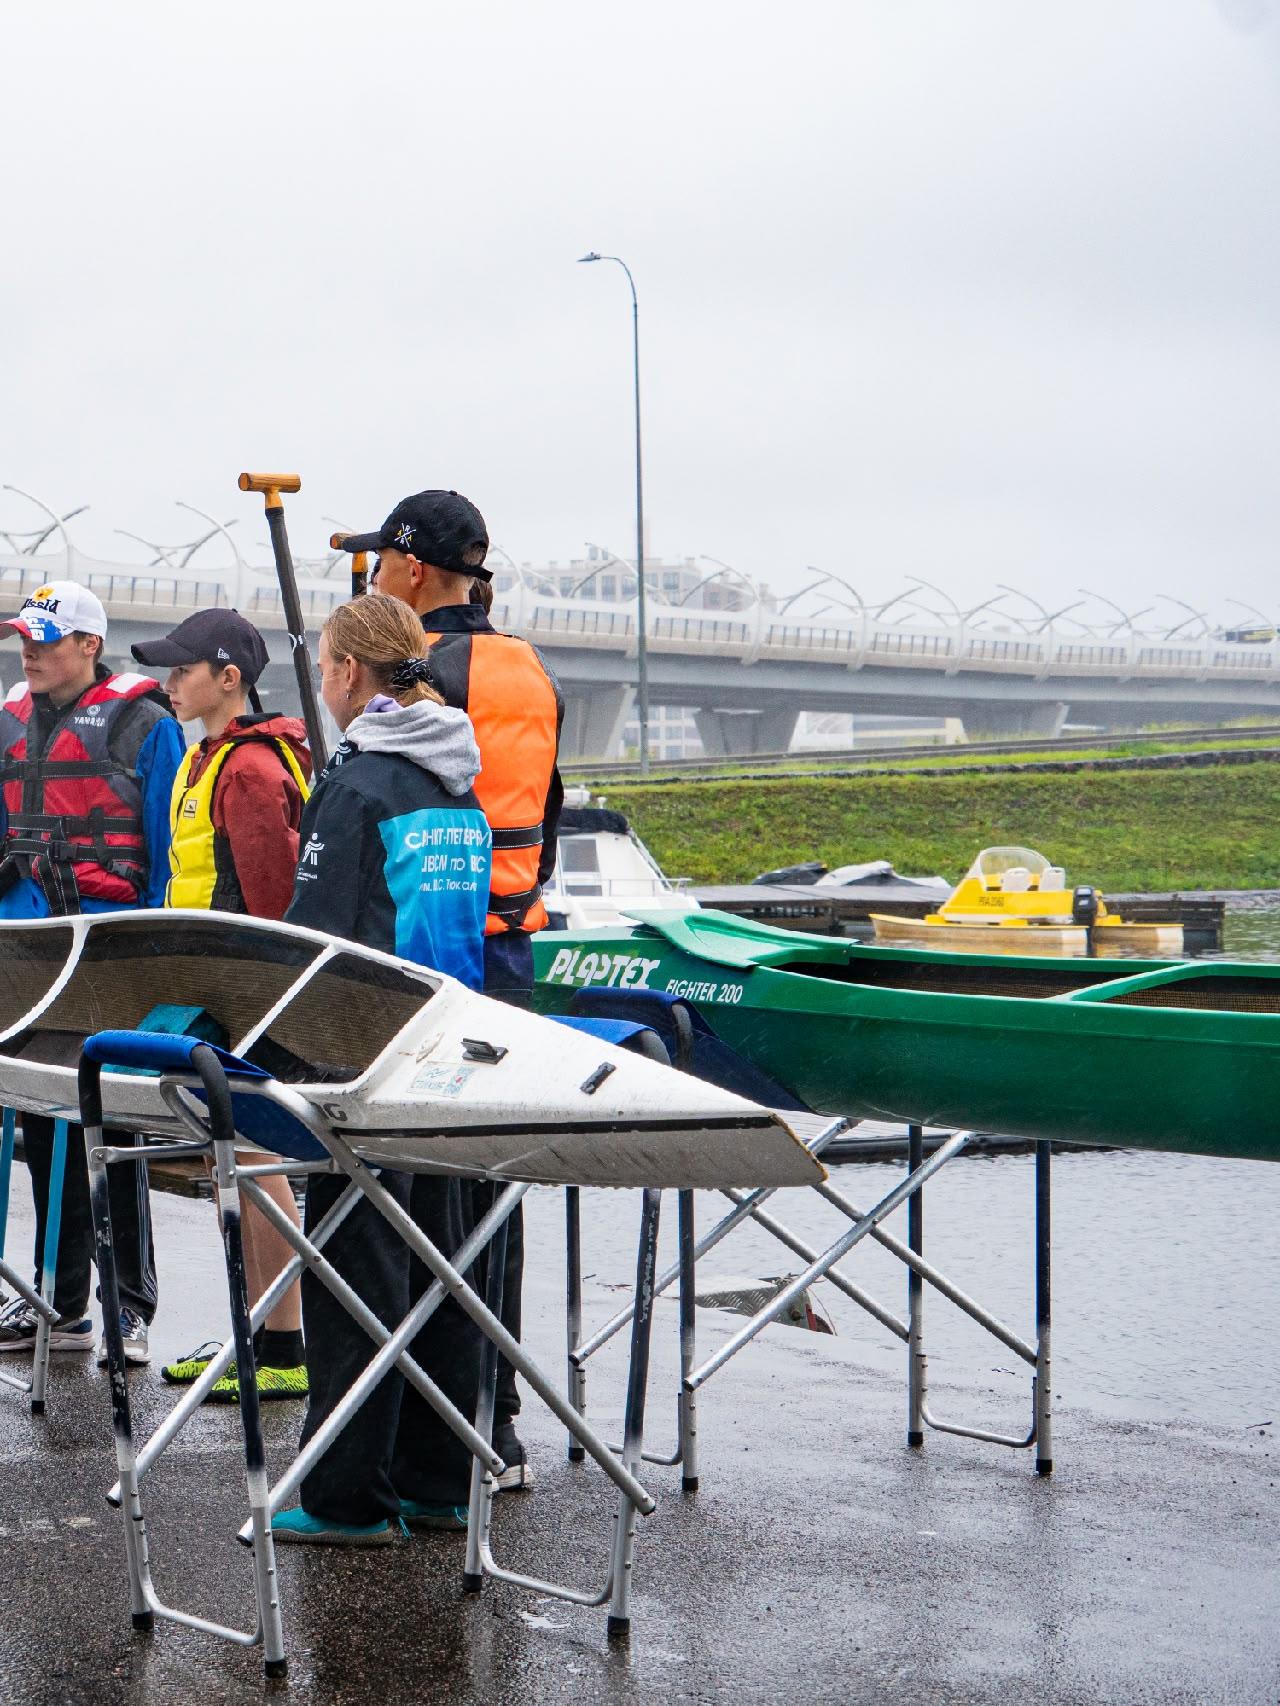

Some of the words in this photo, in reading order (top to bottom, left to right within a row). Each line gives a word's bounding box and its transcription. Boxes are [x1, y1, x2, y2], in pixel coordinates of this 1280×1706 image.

[545, 948, 661, 990] PLASTEX
[665, 979, 718, 1002] FIGHTER
[716, 983, 744, 1004] 200
